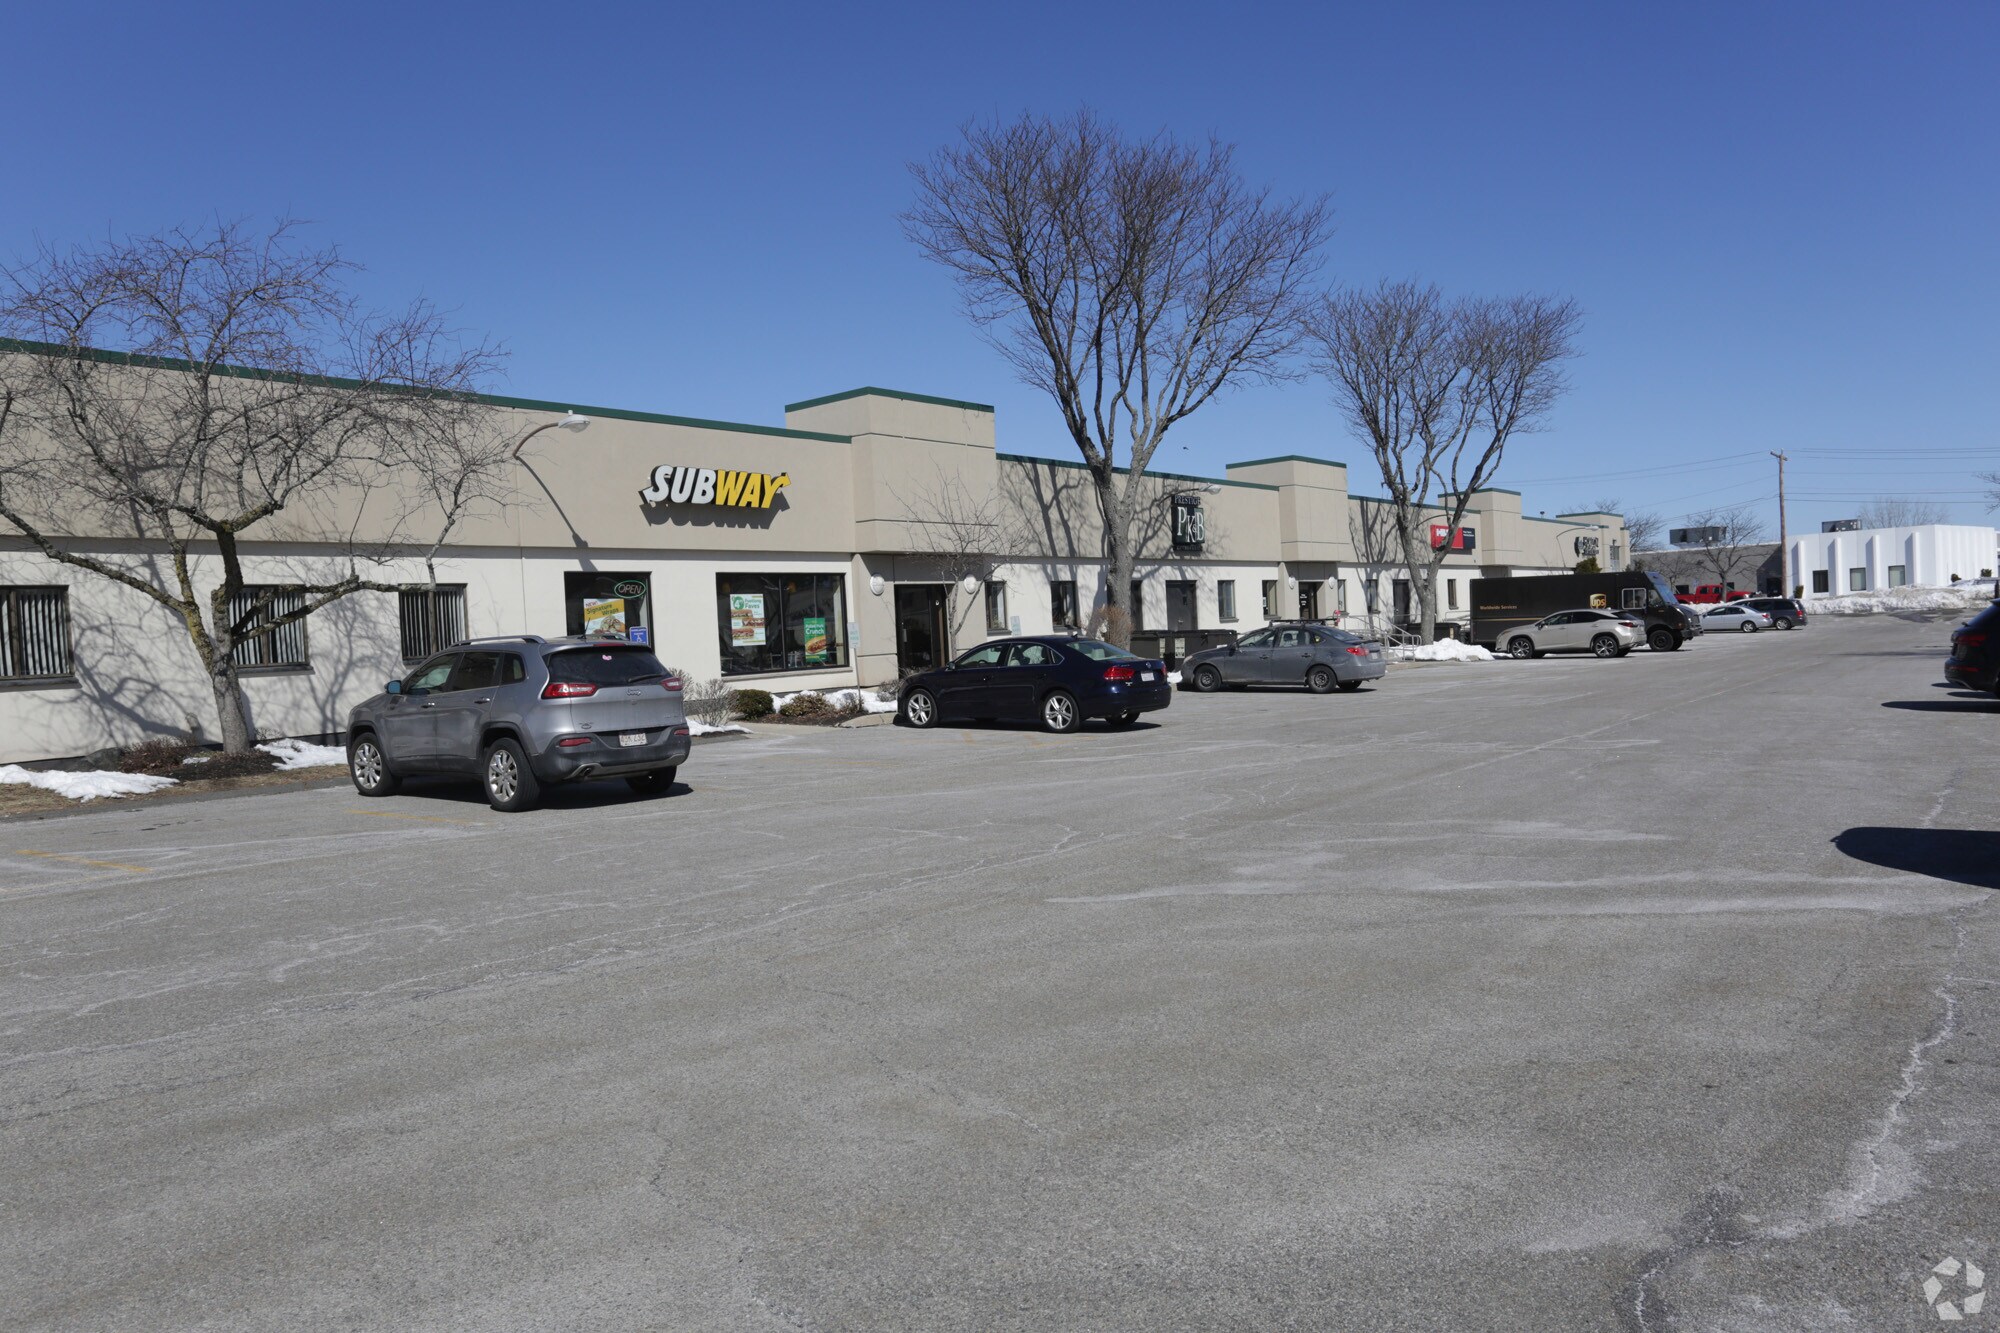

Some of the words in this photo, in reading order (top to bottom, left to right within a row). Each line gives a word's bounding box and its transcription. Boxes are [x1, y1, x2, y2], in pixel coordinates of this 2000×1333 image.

[640, 464, 791, 509] SUBWAY
[1175, 495, 1201, 504] PRESTIGE
[618, 584, 642, 594] OPEN
[586, 604, 613, 615] Signature
[602, 608, 619, 616] Wraps
